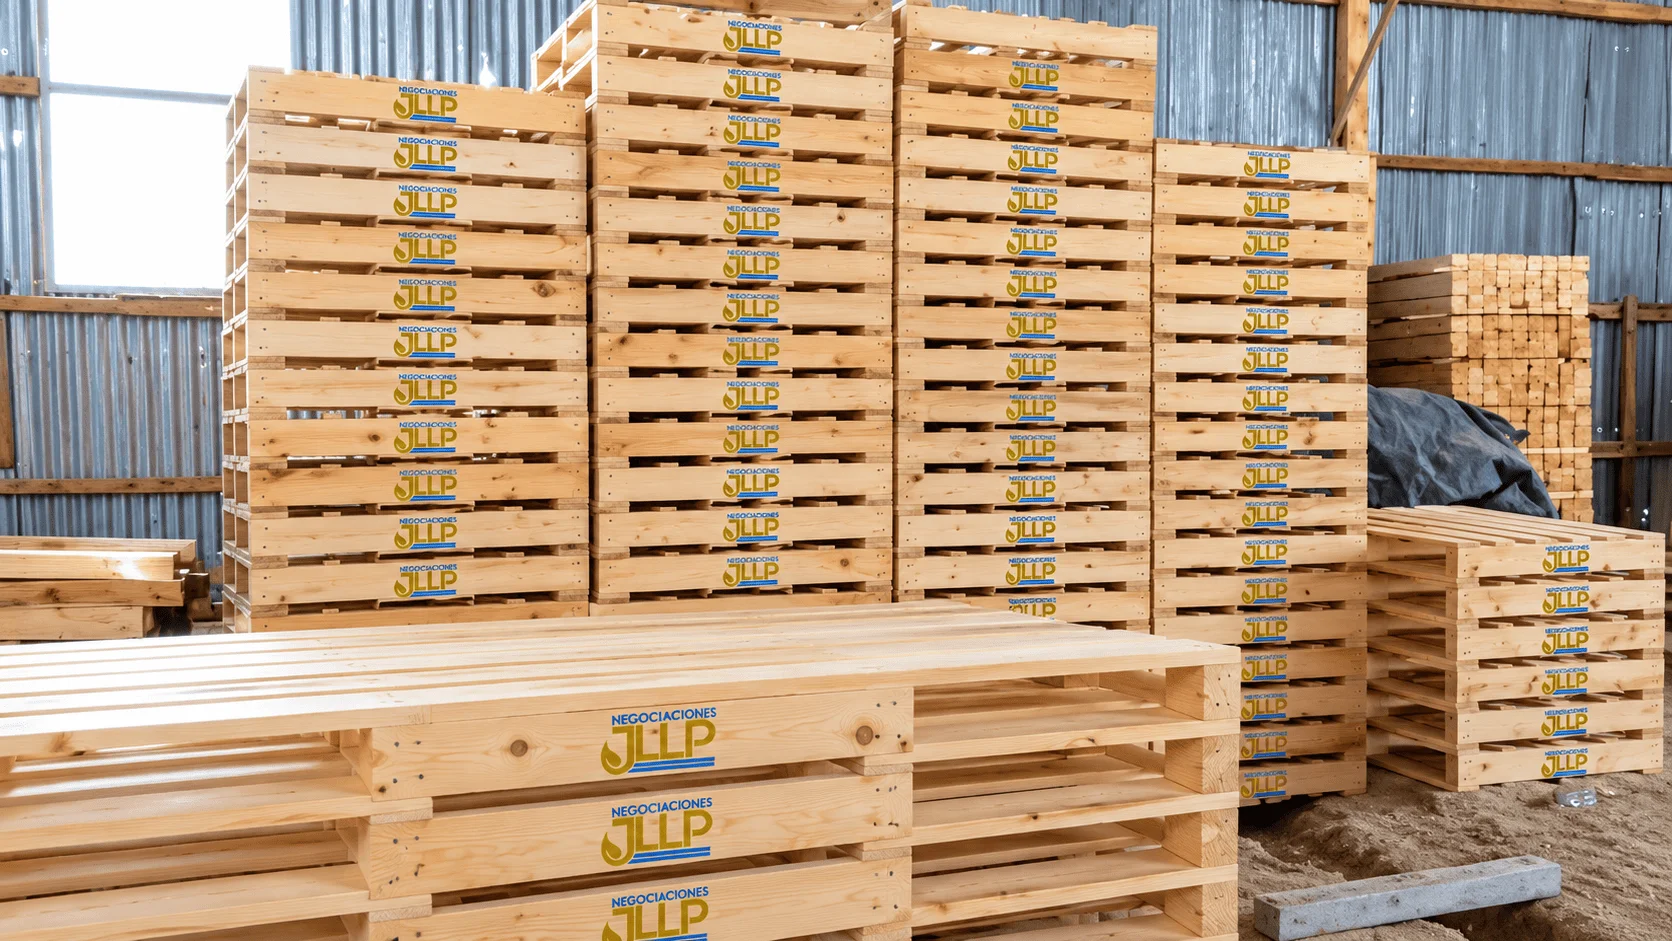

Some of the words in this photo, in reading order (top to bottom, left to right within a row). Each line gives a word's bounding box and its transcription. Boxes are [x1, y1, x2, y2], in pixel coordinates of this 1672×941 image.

[723, 27, 782, 51] JLLP
[723, 75, 781, 98] JLLP
[1009, 67, 1059, 89] JLLP
[393, 93, 458, 119] JLLP
[1008, 108, 1059, 129] JLLP
[723, 121, 781, 144] JLLP
[394, 144, 457, 168] JLLP
[1008, 150, 1058, 171] JLLP
[1244, 157, 1290, 176] JLLP
[723, 166, 781, 190] JLLP
[394, 191, 457, 216] JLLP
[1007, 192, 1057, 213] JLLP
[1244, 197, 1290, 216] JLLP
[723, 212, 780, 234] JLLP
[393, 238, 456, 263] JLLP
[1006, 233, 1057, 255] JLLP
[1243, 236, 1289, 255] JLLP
[723, 256, 780, 278] JLLP
[1007, 276, 1057, 297] JLLP
[1243, 275, 1288, 294] JLLP
[394, 286, 457, 310] JLLP
[723, 299, 779, 322] JLLP
[1006, 317, 1057, 338] JLLP
[1243, 313, 1288, 333] JLLP
[394, 333, 457, 357] JLLP
[723, 343, 780, 365] JLLP
[1006, 359, 1056, 380] JLLP
[1243, 352, 1288, 371] JLLP
[394, 380, 457, 405] JLLP
[723, 387, 779, 410] JLLP
[1243, 391, 1288, 411] JLLP
[1006, 400, 1056, 421] JLLP
[394, 428, 457, 454] JLLP
[723, 430, 780, 453] JLLP
[1006, 440, 1056, 461] JLLP
[1242, 430, 1288, 449] JLLP
[394, 475, 457, 503] JLLP
[723, 474, 779, 498] JLLP
[1242, 468, 1288, 489] JLLP
[1006, 481, 1056, 503] JLLP
[1242, 506, 1288, 526] JLLP
[394, 523, 457, 550] JLLP
[723, 518, 779, 542] JLLP
[1006, 522, 1056, 543] JLLP
[1242, 544, 1288, 565] JLLP
[1543, 551, 1589, 572] JLLP
[394, 570, 457, 598] JLLP
[723, 562, 779, 587] JLLP
[1006, 563, 1056, 585] JLLP
[1241, 583, 1288, 604] JLLP
[1543, 591, 1589, 614] JLLP
[1242, 621, 1288, 642] JLLP
[1542, 632, 1589, 654] JLLP
[1542, 672, 1588, 695] JLLP
[611, 706, 717, 726] NEGOCIACIONES
[1541, 714, 1588, 736] JLLP
[601, 719, 716, 775] JLLP
[1541, 754, 1587, 778] JLLP
[611, 797, 713, 818] NEGOCIACIONES
[601, 809, 713, 866] JLLP
[611, 886, 709, 908] NEGOCIACIONES
[602, 898, 708, 941] JLLP
